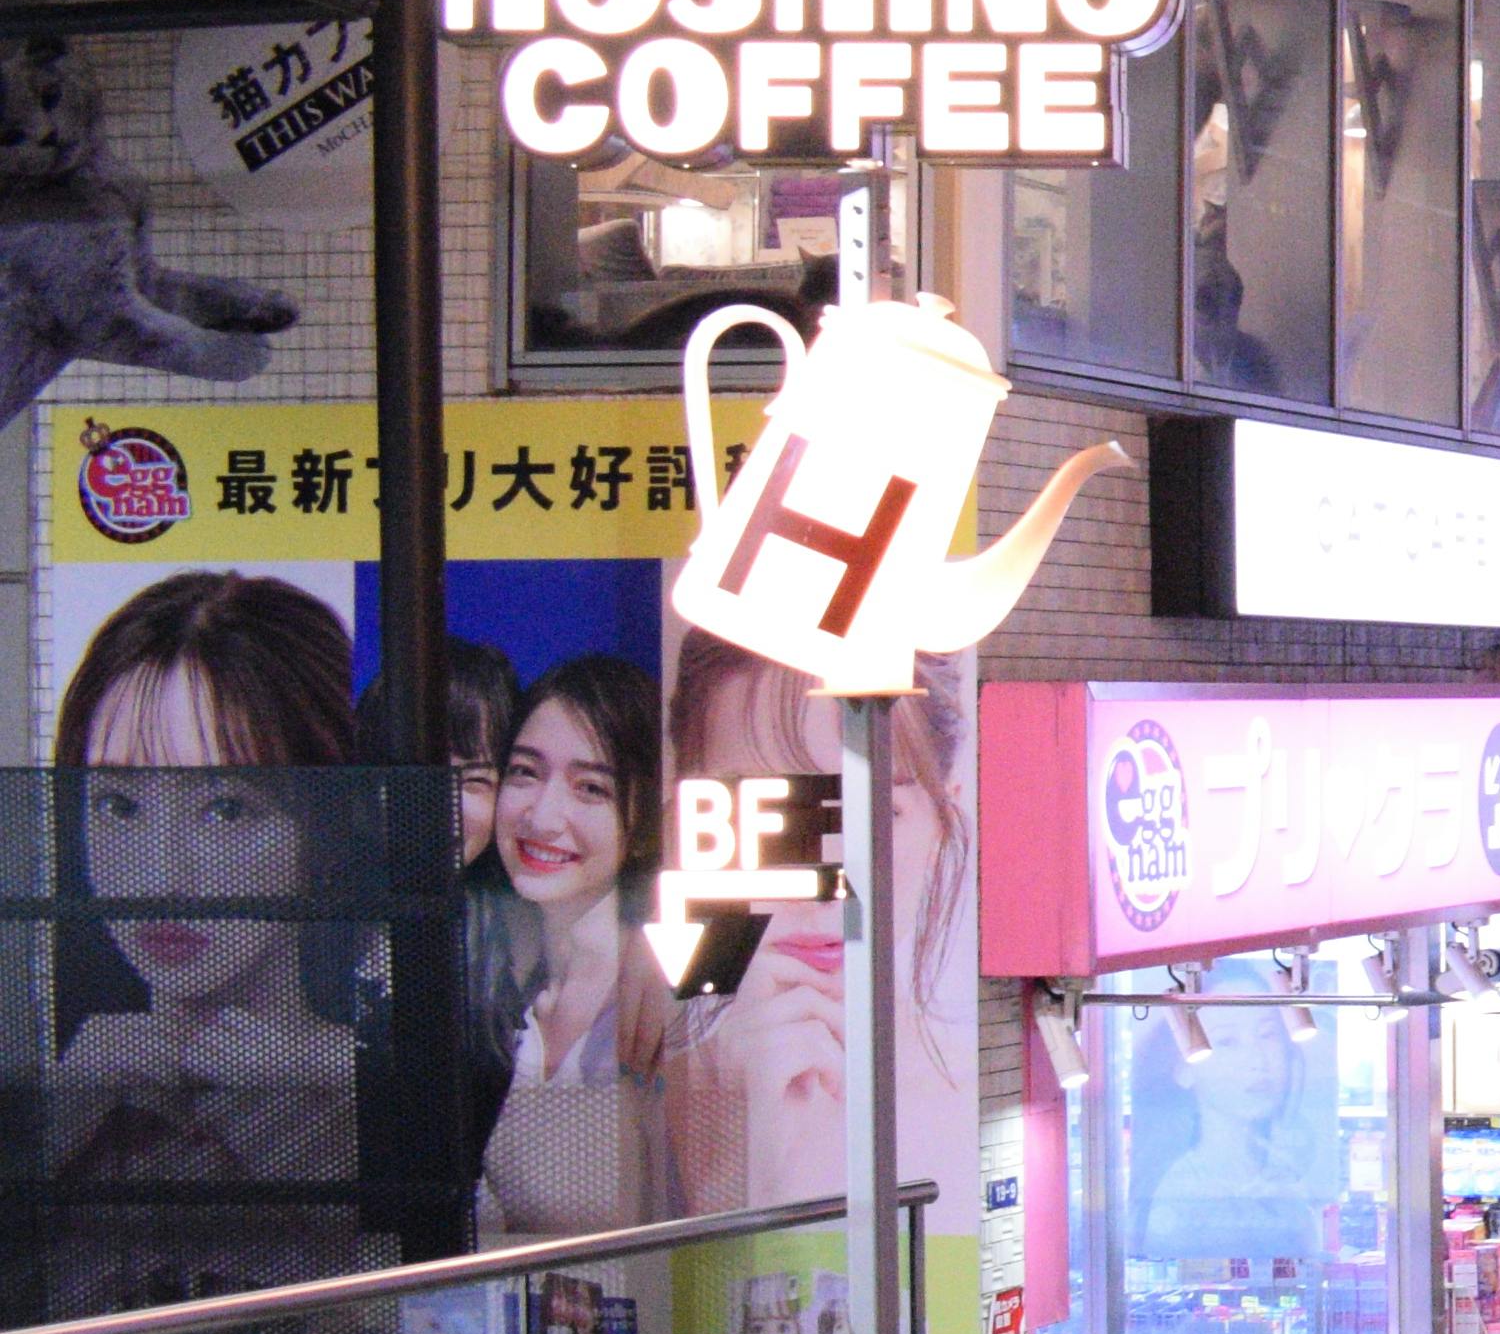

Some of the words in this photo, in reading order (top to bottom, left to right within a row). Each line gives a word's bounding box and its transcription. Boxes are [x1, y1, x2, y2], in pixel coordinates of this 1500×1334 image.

[208, 19, 373, 130] 猫カフ
[244, 99, 325, 159] THIS
[325, 65, 374, 107] WA
[501, 38, 1109, 156] COFFEE
[82, 446, 174, 501] egg
[110, 484, 193, 523] nam
[216, 446, 742, 518] 最新大好評
[717, 433, 917, 639] H
[674, 777, 790, 870] BF
[1106, 746, 1177, 839] egg
[1127, 840, 1188, 884] nam
